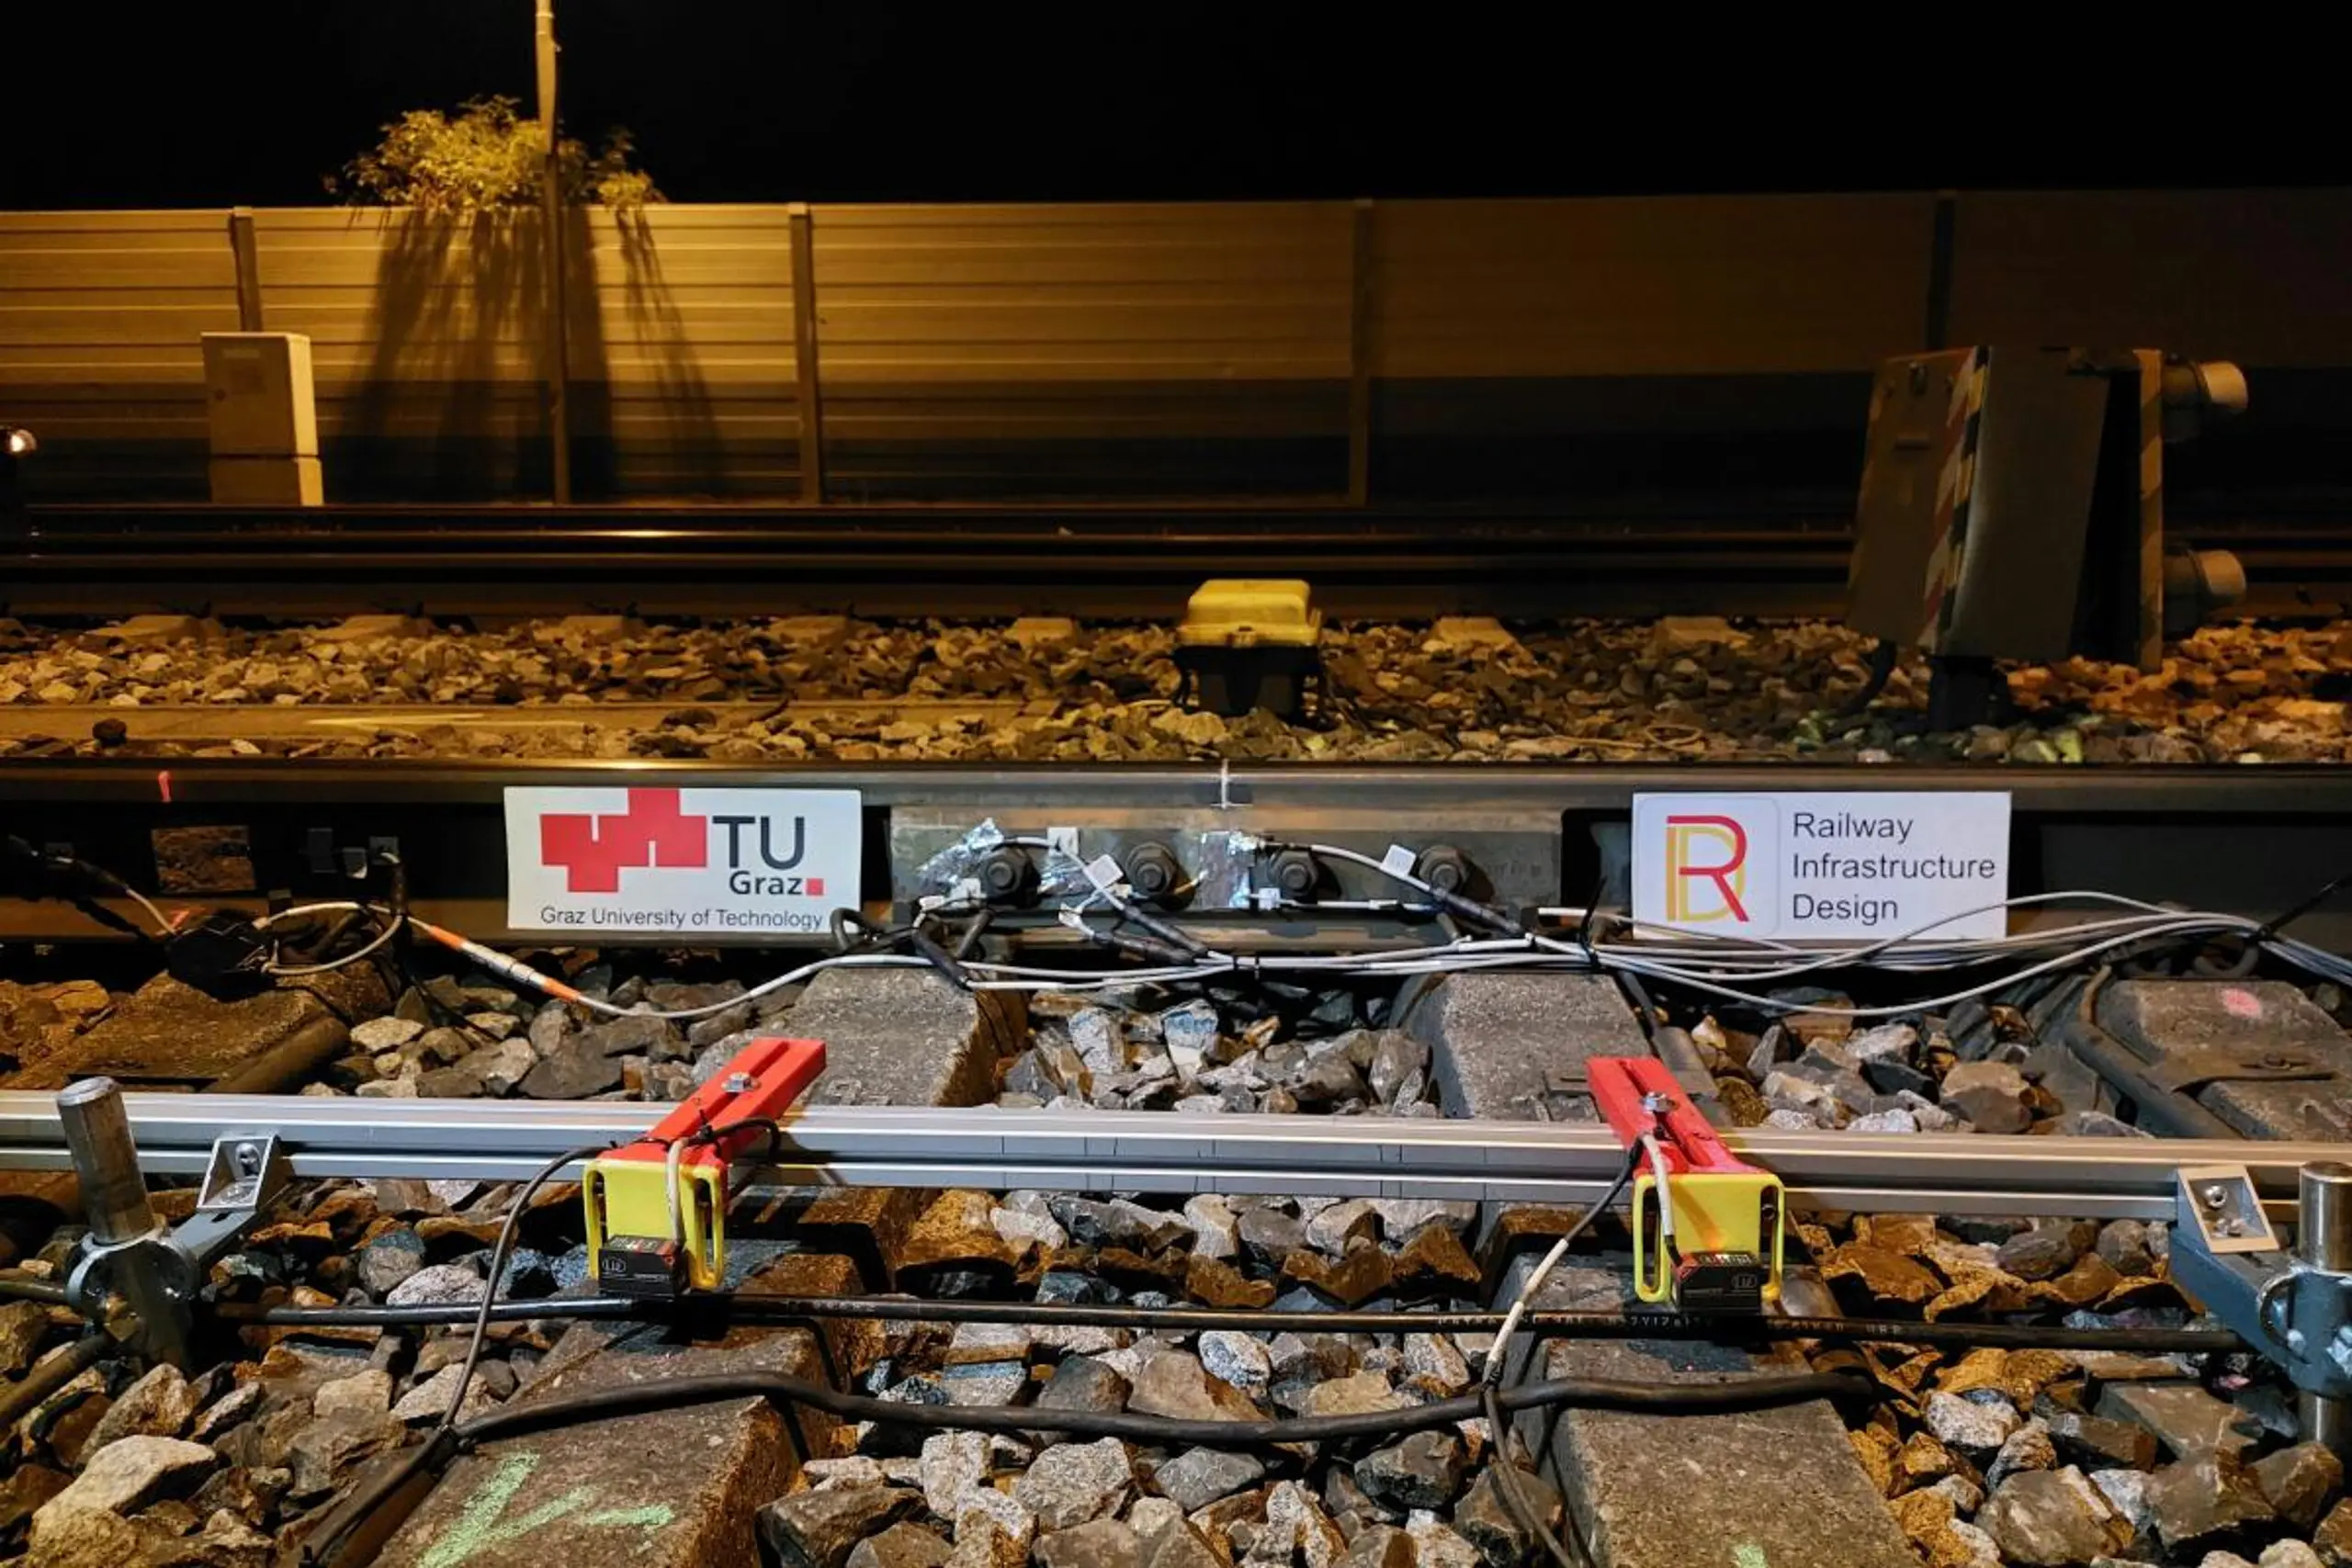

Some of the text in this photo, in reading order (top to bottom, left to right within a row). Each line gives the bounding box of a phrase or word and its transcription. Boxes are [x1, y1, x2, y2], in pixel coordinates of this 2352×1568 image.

[1792, 812, 1913, 844] Railway
[712, 816, 805, 870] TU
[1792, 853, 1996, 879] Infrastructure
[729, 871, 803, 896] Graz
[540, 907, 823, 931] Graz University of Technology
[1792, 894, 1898, 925] Design
